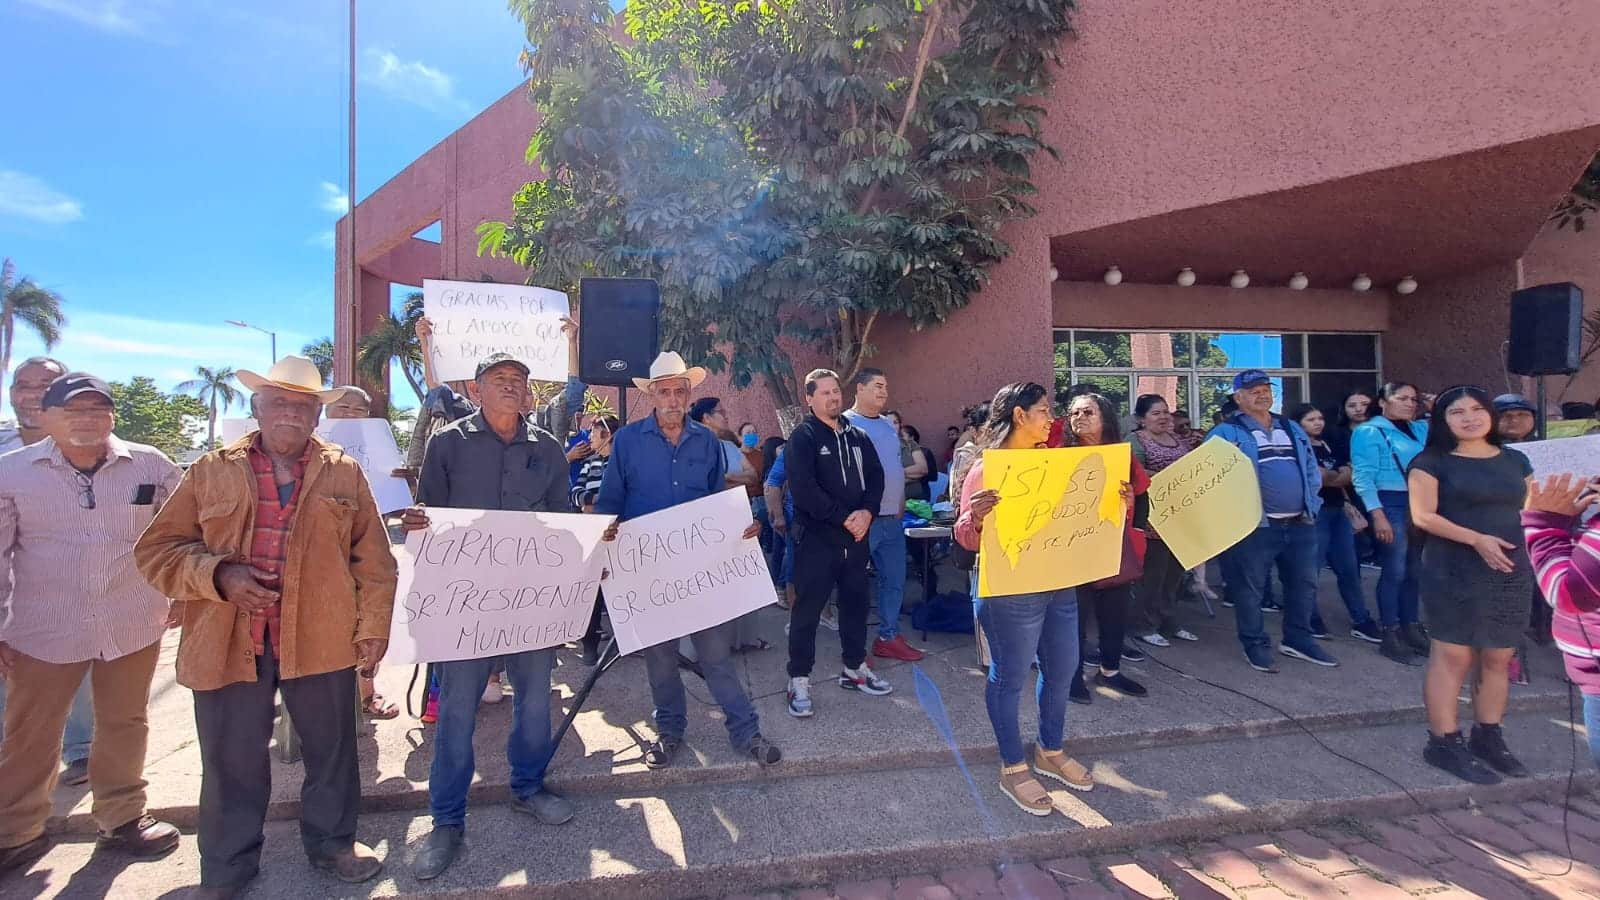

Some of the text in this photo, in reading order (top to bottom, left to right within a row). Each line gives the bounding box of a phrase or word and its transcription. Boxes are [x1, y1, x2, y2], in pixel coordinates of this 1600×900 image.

[440, 289, 508, 312] GRACIAS
[465, 318, 522, 337] APOYO
[1063, 468, 1103, 495] SE
[1024, 495, 1098, 532] PUDO!
[445, 579, 598, 616] PRESIDENTE
[611, 549, 767, 625] SR. GOBERNADOR
[456, 606, 591, 654] MUNICIPAL!
